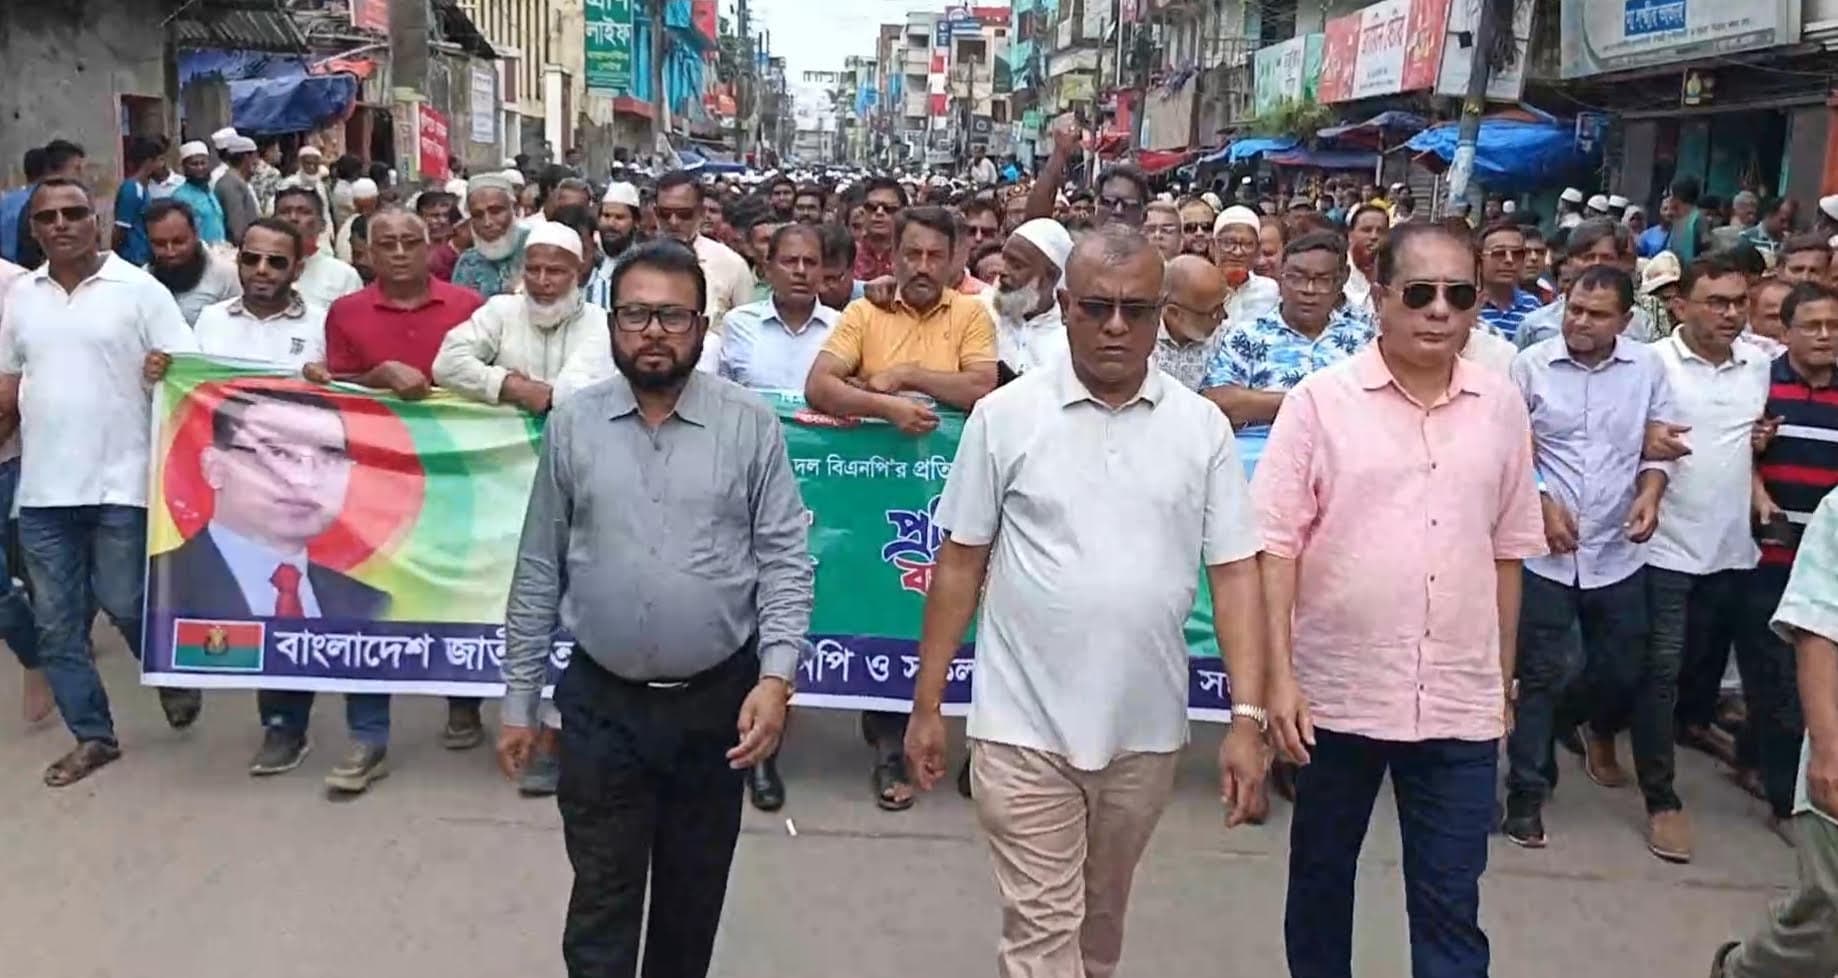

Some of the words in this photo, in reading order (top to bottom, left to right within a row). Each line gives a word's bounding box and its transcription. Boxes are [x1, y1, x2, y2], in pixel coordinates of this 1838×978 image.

[826, 453, 907, 478] বিএনপি'র
[273, 628, 435, 669] বাংলাদেশ
[865, 655, 890, 682] ও
